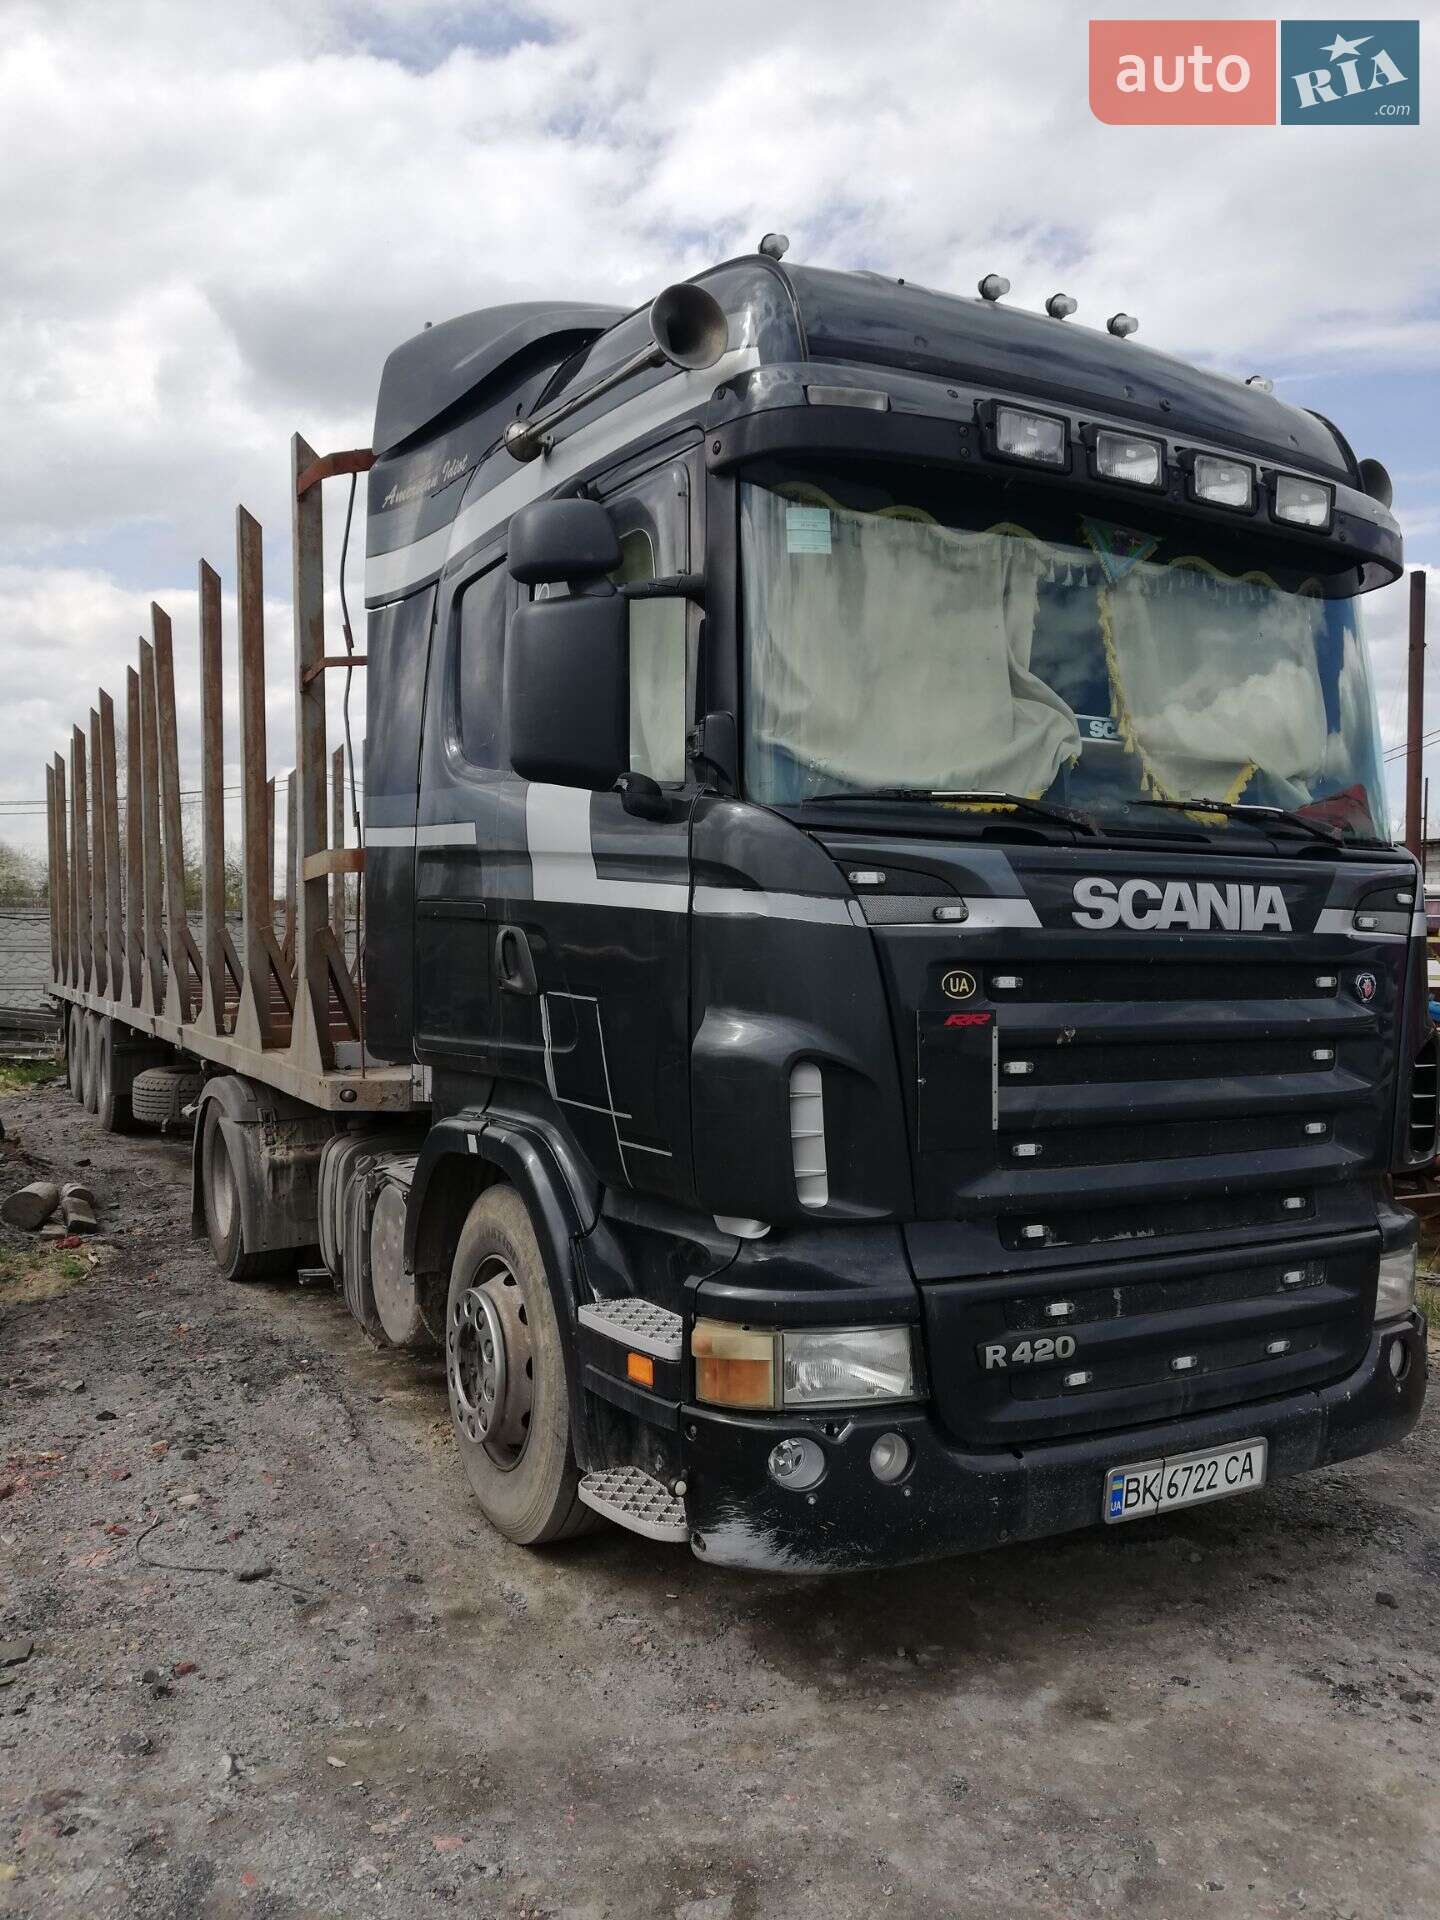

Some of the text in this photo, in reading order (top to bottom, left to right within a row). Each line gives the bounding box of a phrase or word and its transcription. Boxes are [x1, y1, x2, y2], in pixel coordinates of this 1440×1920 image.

[1072, 877, 1292, 932] SCANIA
[950, 977, 970, 993] UA
[985, 1335, 1076, 1369] R 420
[1124, 1451, 1254, 1508] BK 6722 CA
[1110, 1501, 1122, 1512] UA
